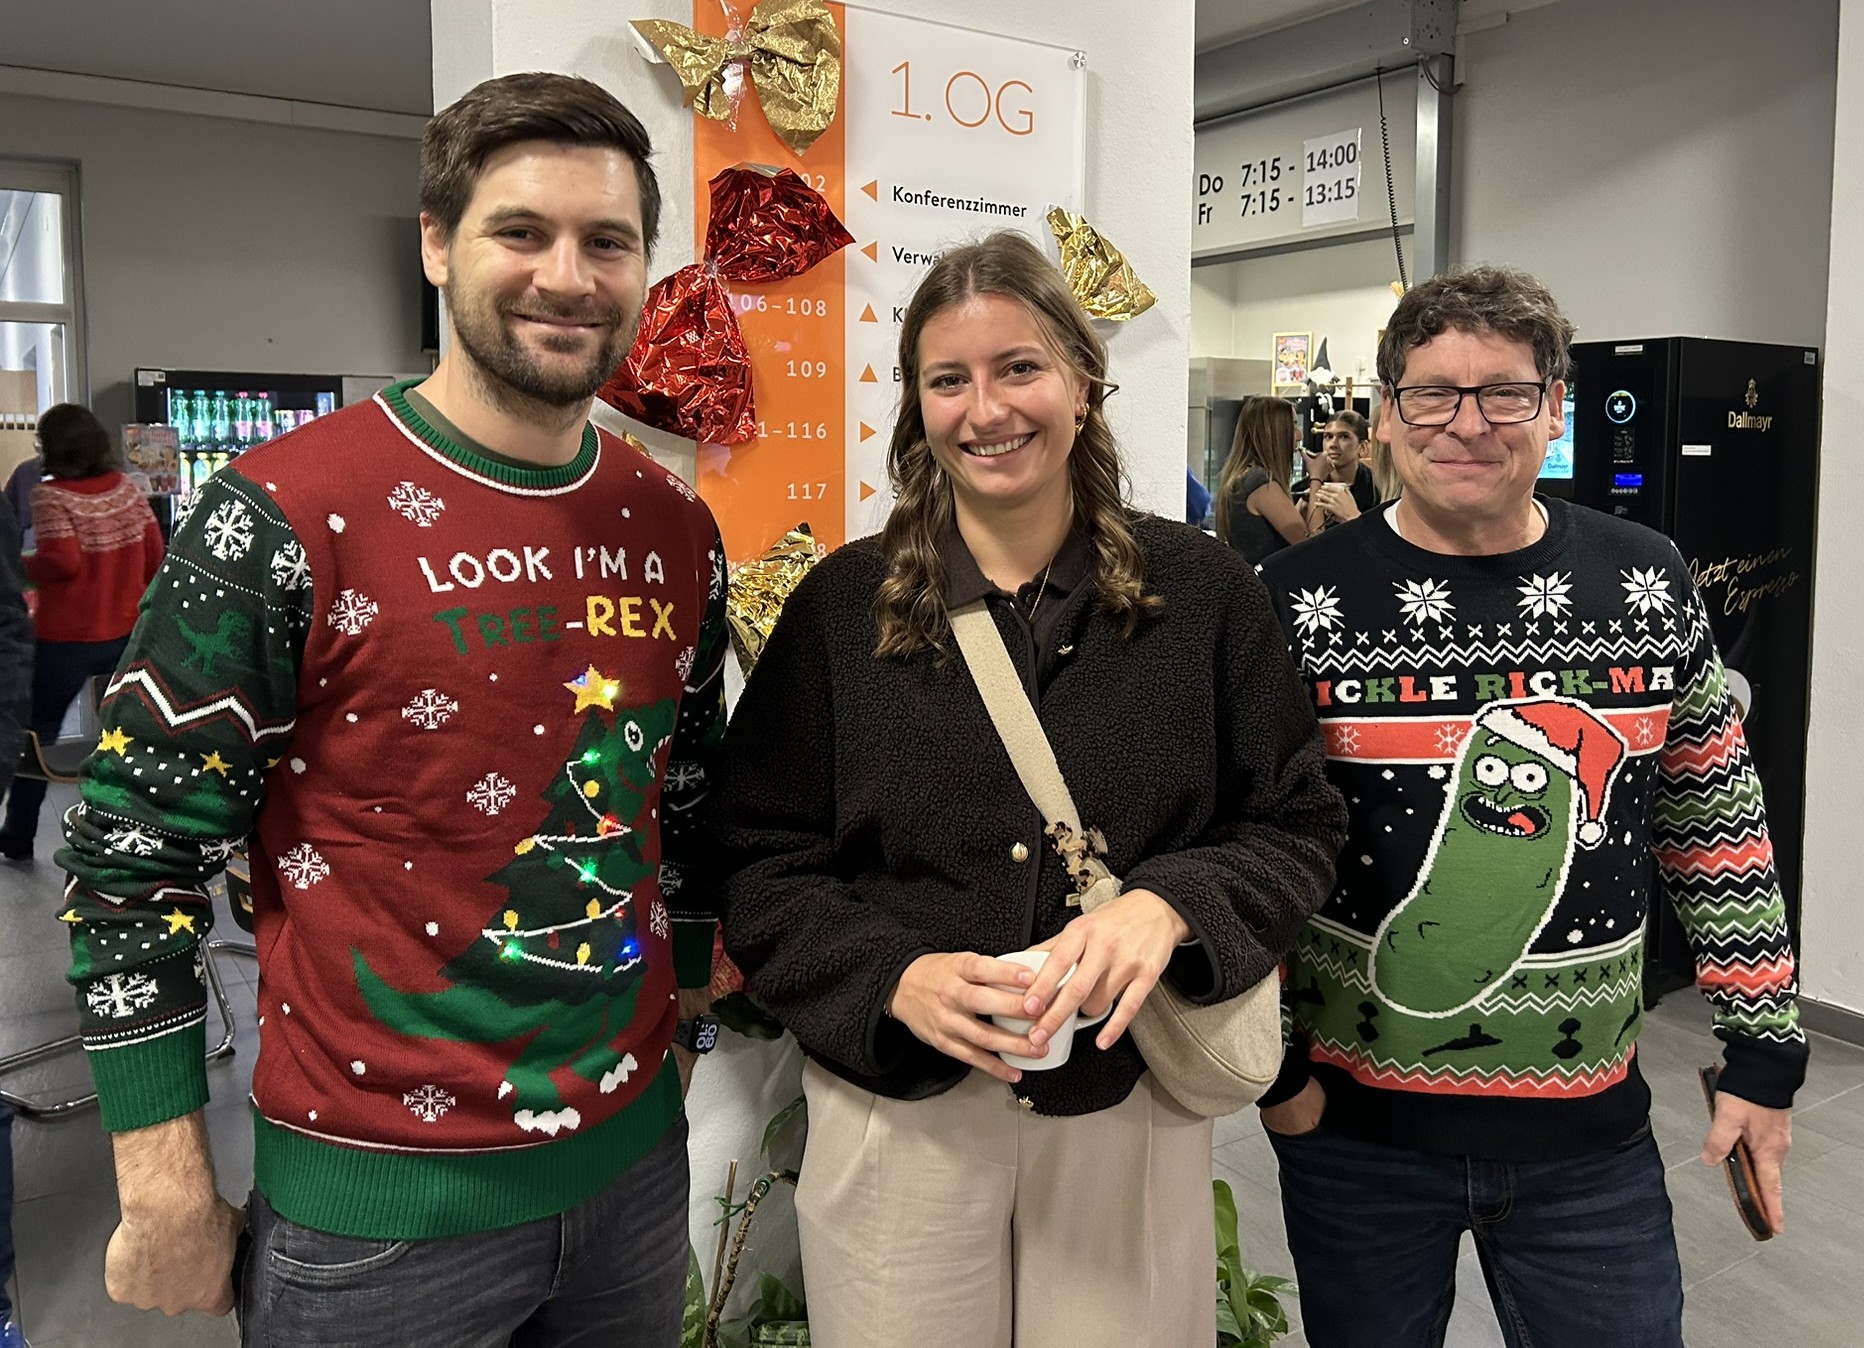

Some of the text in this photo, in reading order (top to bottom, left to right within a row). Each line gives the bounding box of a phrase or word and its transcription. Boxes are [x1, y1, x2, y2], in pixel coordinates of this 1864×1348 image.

[891, 61, 1033, 136] 1. OG
[800, 172, 826, 192] 02
[1199, 173, 1224, 196] Do
[1241, 157, 1281, 187] 7:15
[1306, 142, 1357, 173] 14:00
[893, 185, 1027, 218] Konferenzzimmer
[1198, 203, 1213, 225] Fr
[1241, 188, 1280, 217] 7:15
[1305, 177, 1356, 207] 13:15
[786, 360, 827, 378] 109
[757, 421, 827, 439] 1-116
[1728, 410, 1773, 432] Dallmayr
[786, 483, 827, 501] 117
[417, 545, 665, 592] LOOK I'M A
[1737, 547, 1792, 574] einen
[1724, 572, 1799, 616] Espresso
[433, 595, 677, 655] TREE-REX
[1304, 675, 1459, 707] ICKLE
